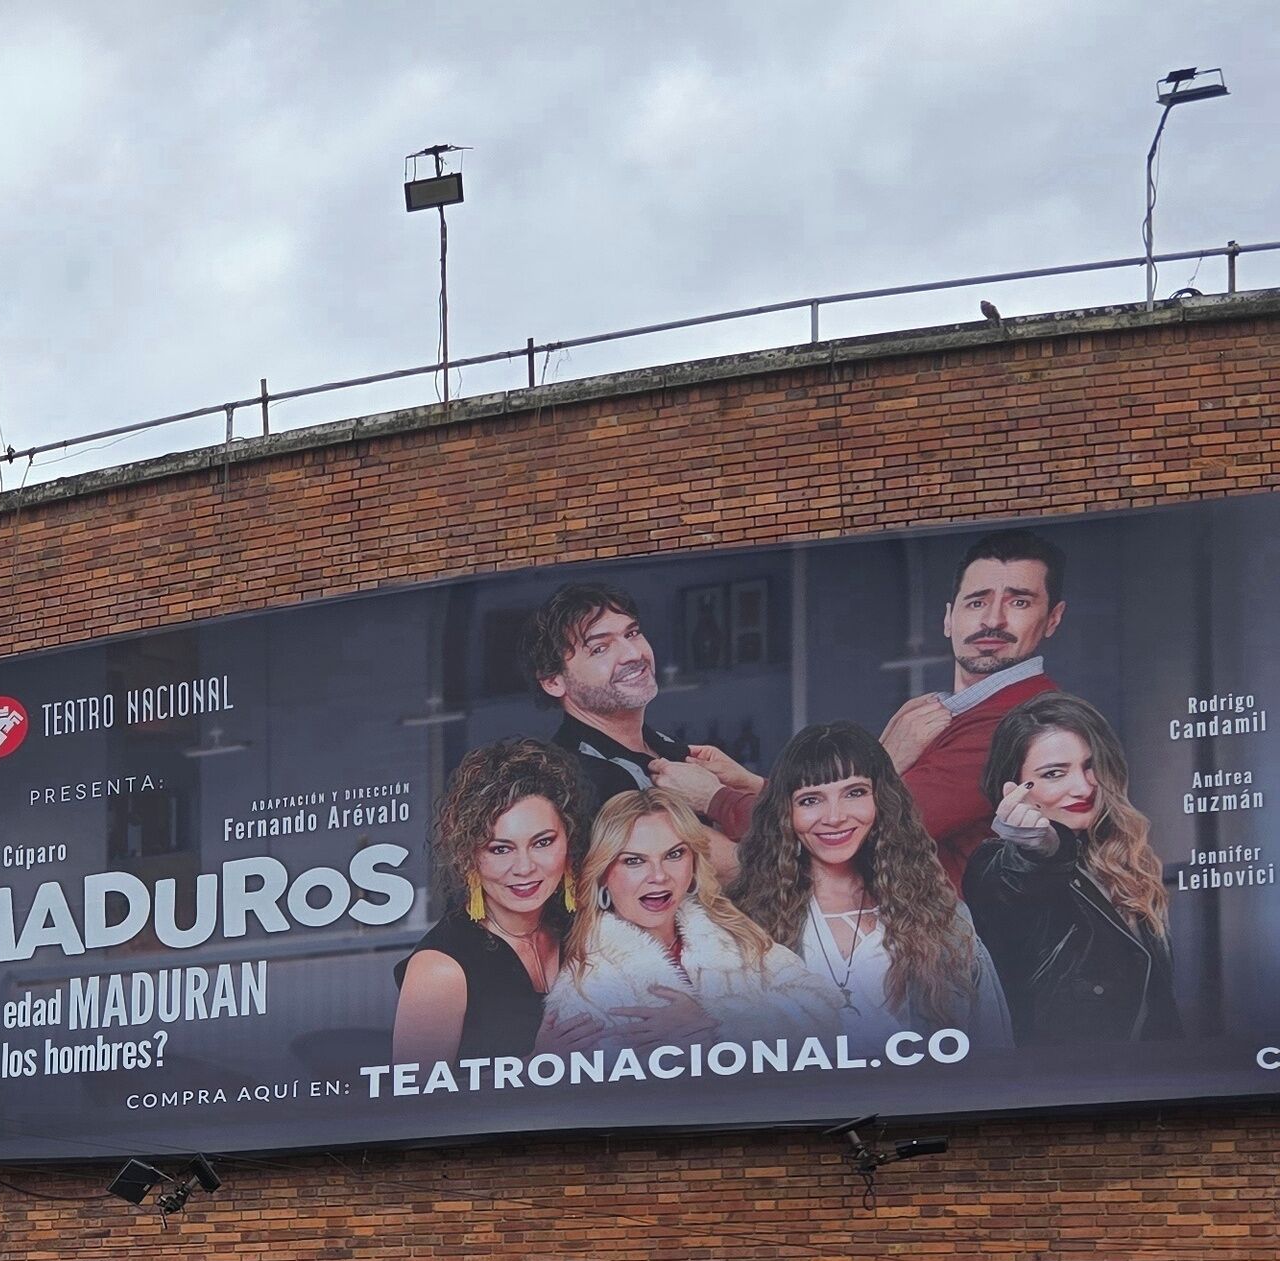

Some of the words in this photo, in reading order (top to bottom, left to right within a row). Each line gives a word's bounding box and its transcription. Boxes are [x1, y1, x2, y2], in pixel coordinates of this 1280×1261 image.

[42, 694, 114, 737] TEATRO
[127, 675, 234, 724] NACIONAL
[1188, 693, 1255, 714] Rodrigo
[1169, 710, 1267, 740] Candamil
[30, 775, 165, 806] PRESENTA:
[1192, 769, 1253, 789] Andrea
[251, 792, 325, 812] ADAPTACIÓN
[332, 791, 338, 802] Y
[345, 782, 410, 800] DIRECCIÓN
[1183, 789, 1264, 814] Guzmán
[224, 810, 317, 841] Fernando
[328, 799, 410, 829] Arévalo
[3, 843, 67, 870] Cúparo
[1190, 845, 1261, 866] Jennifer
[1178, 863, 1275, 891] Leibovici
[3, 989, 62, 1030] edad
[69, 960, 267, 1031] MADURAN
[1, 1042, 37, 1078] los
[44, 1030, 168, 1076] hombres?
[126, 1088, 227, 1110] COMPRA
[237, 1079, 299, 1102] AQUÍ
[310, 1080, 351, 1097] EN:
[359, 1028, 971, 1099] TEATRONACIONAL.CO
